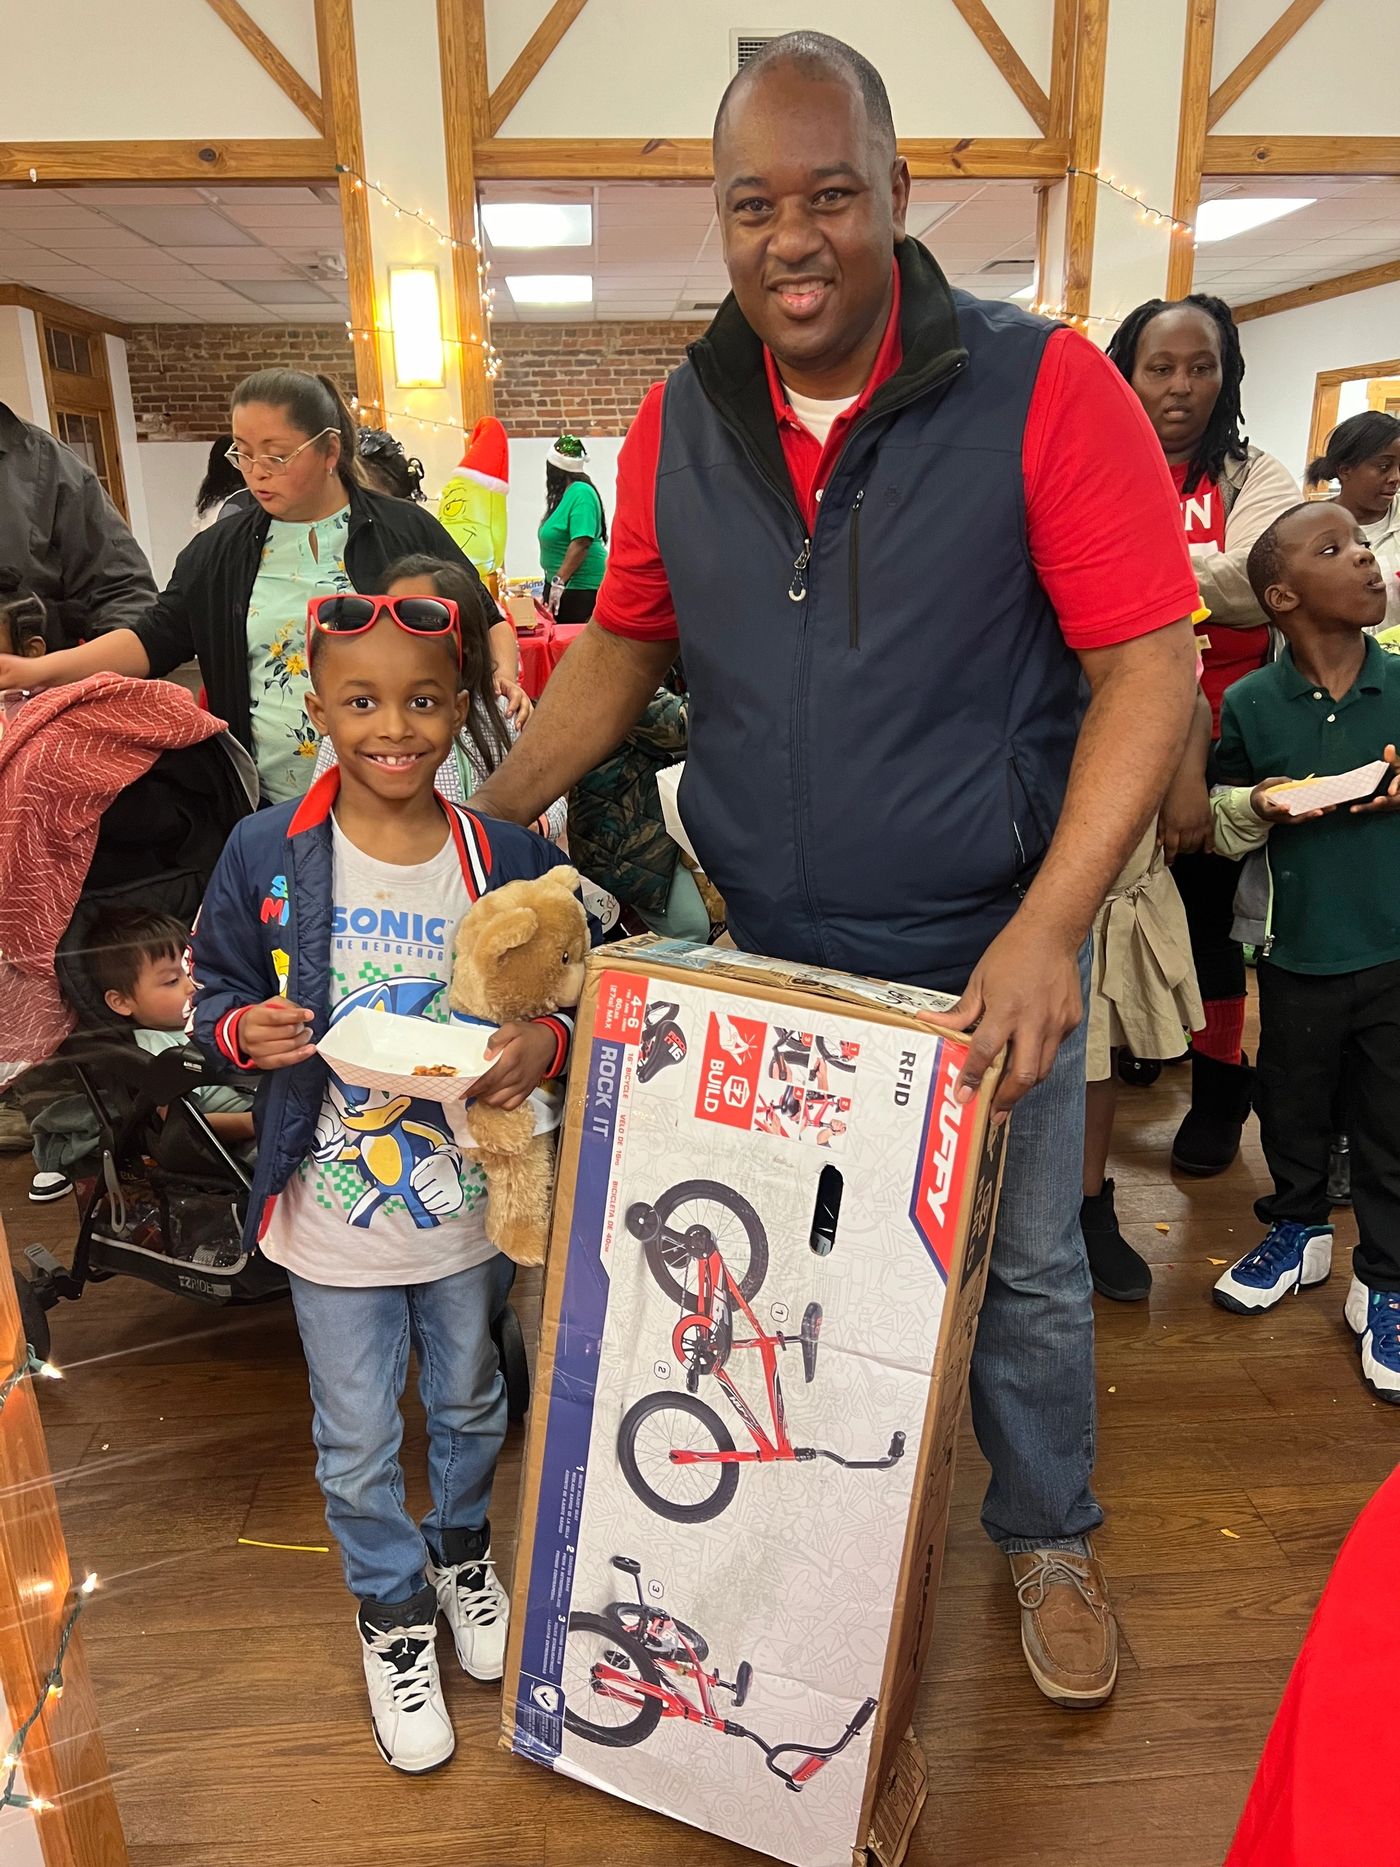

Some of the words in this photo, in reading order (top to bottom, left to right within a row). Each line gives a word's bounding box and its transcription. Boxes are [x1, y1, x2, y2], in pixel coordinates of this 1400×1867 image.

[331, 906, 445, 945] SONIC
[336, 939, 353, 950] HE
[361, 939, 444, 961] HEDGEHOG
[604, 1009, 614, 1029] MAX
[668, 1043, 684, 1060] 16
[595, 1045, 618, 1109] ROCK
[622, 1067, 632, 1099] BICYCLE
[704, 1058, 725, 1113] BUILD
[728, 1078, 745, 1105] EZ
[894, 1050, 917, 1107] RFID
[592, 1116, 610, 1138] IT
[608, 1180, 618, 1218] BICICLETA
[607, 1220, 614, 1230] DE
